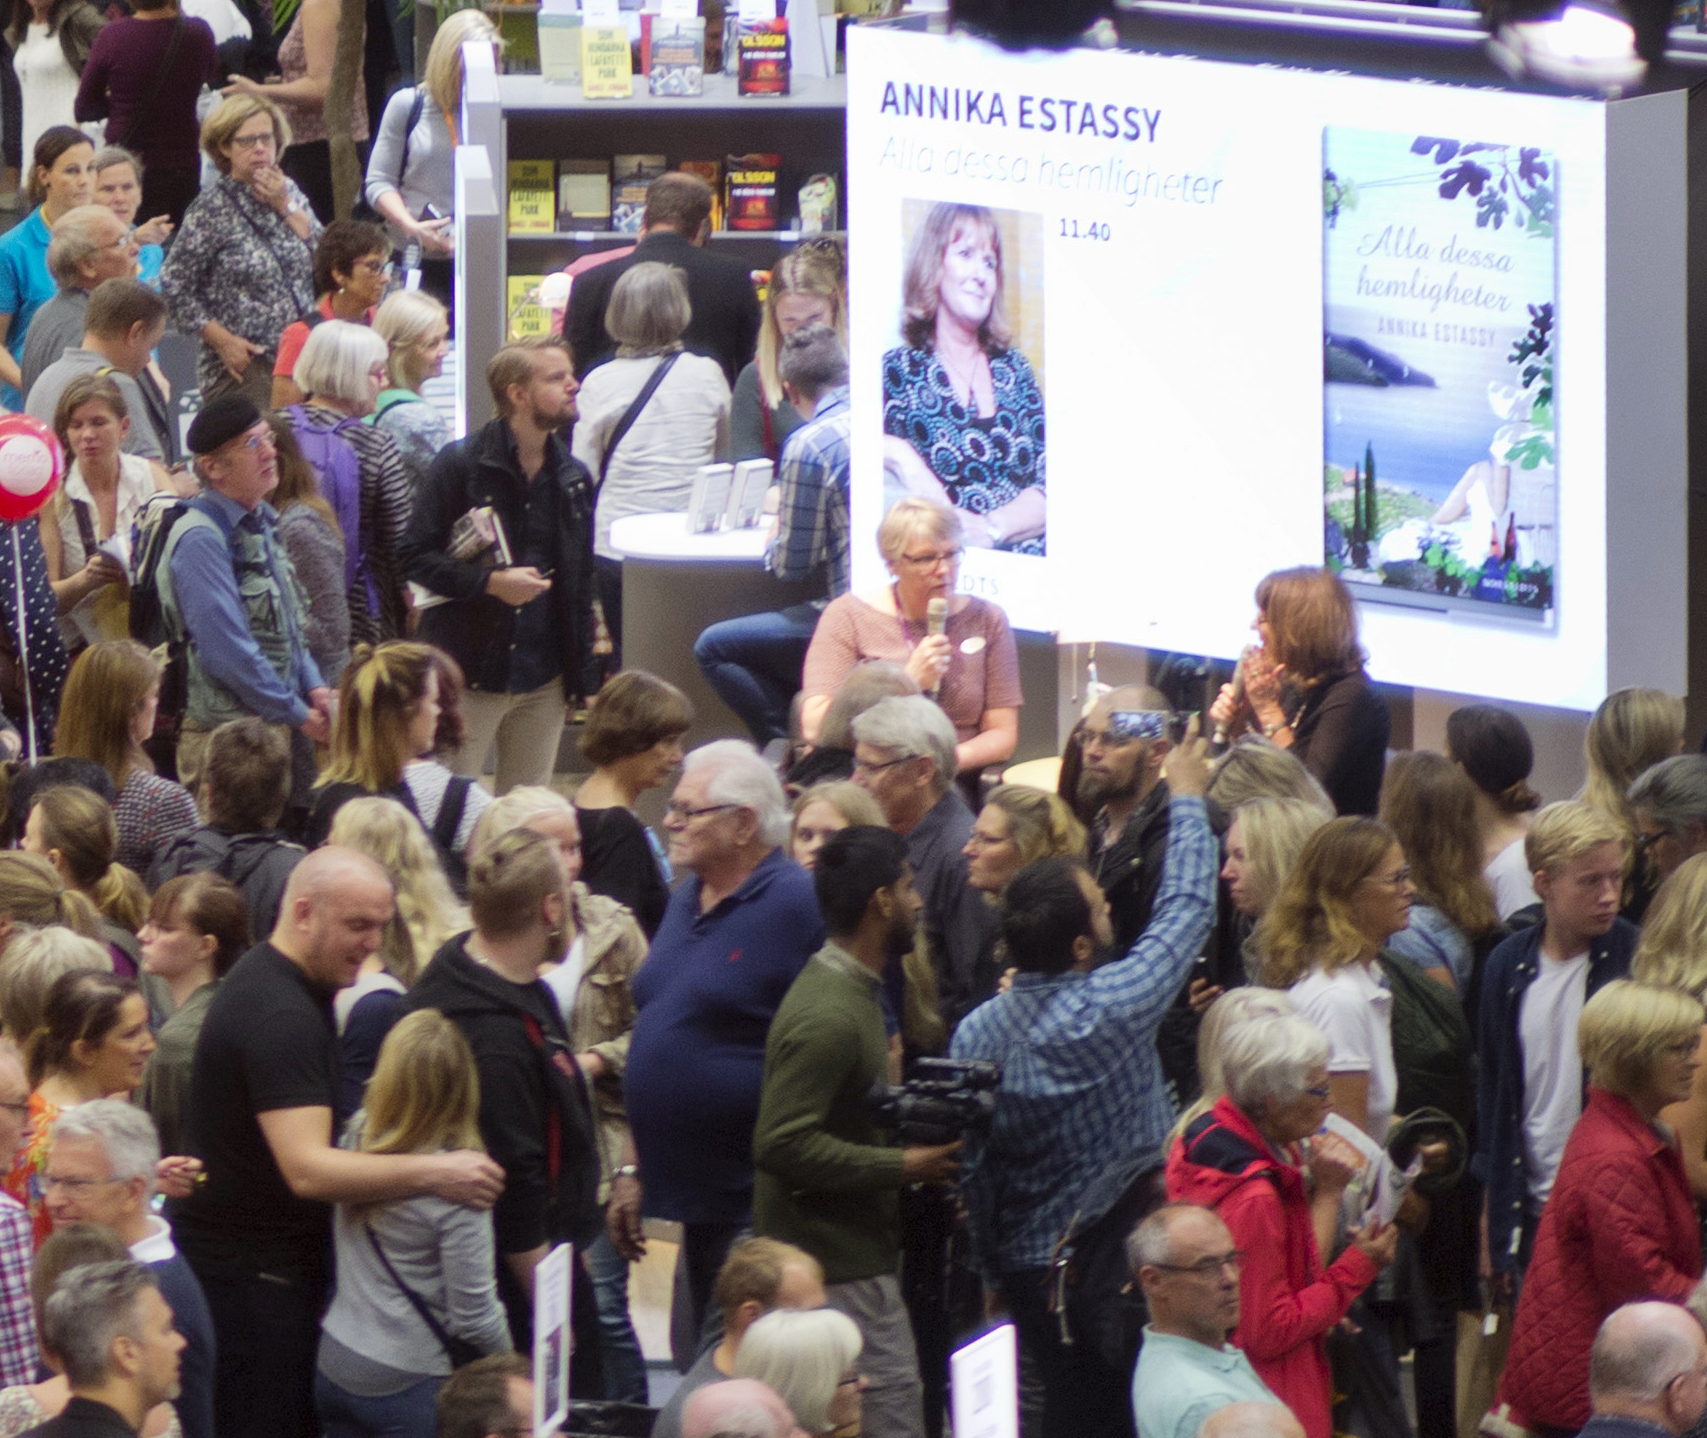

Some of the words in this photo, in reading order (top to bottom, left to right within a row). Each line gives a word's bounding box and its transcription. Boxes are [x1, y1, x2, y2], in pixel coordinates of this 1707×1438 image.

[741, 34, 786, 47] OLSSON
[880, 81, 1007, 127] ANNIKA
[1019, 95, 1162, 143] ESTASSY
[731, 171, 777, 184] OLSSON
[880, 136, 934, 173] Alla
[944, 144, 1029, 183] dessa
[1039, 152, 1224, 207] hemligheter
[1060, 217, 1111, 241] 11.40
[1356, 224, 1433, 260] Alla
[1440, 233, 1515, 274] dessa
[1356, 263, 1512, 314] hemligheter
[1378, 316, 1428, 339] ANNIKA
[1434, 321, 1496, 348] ESTASSY
